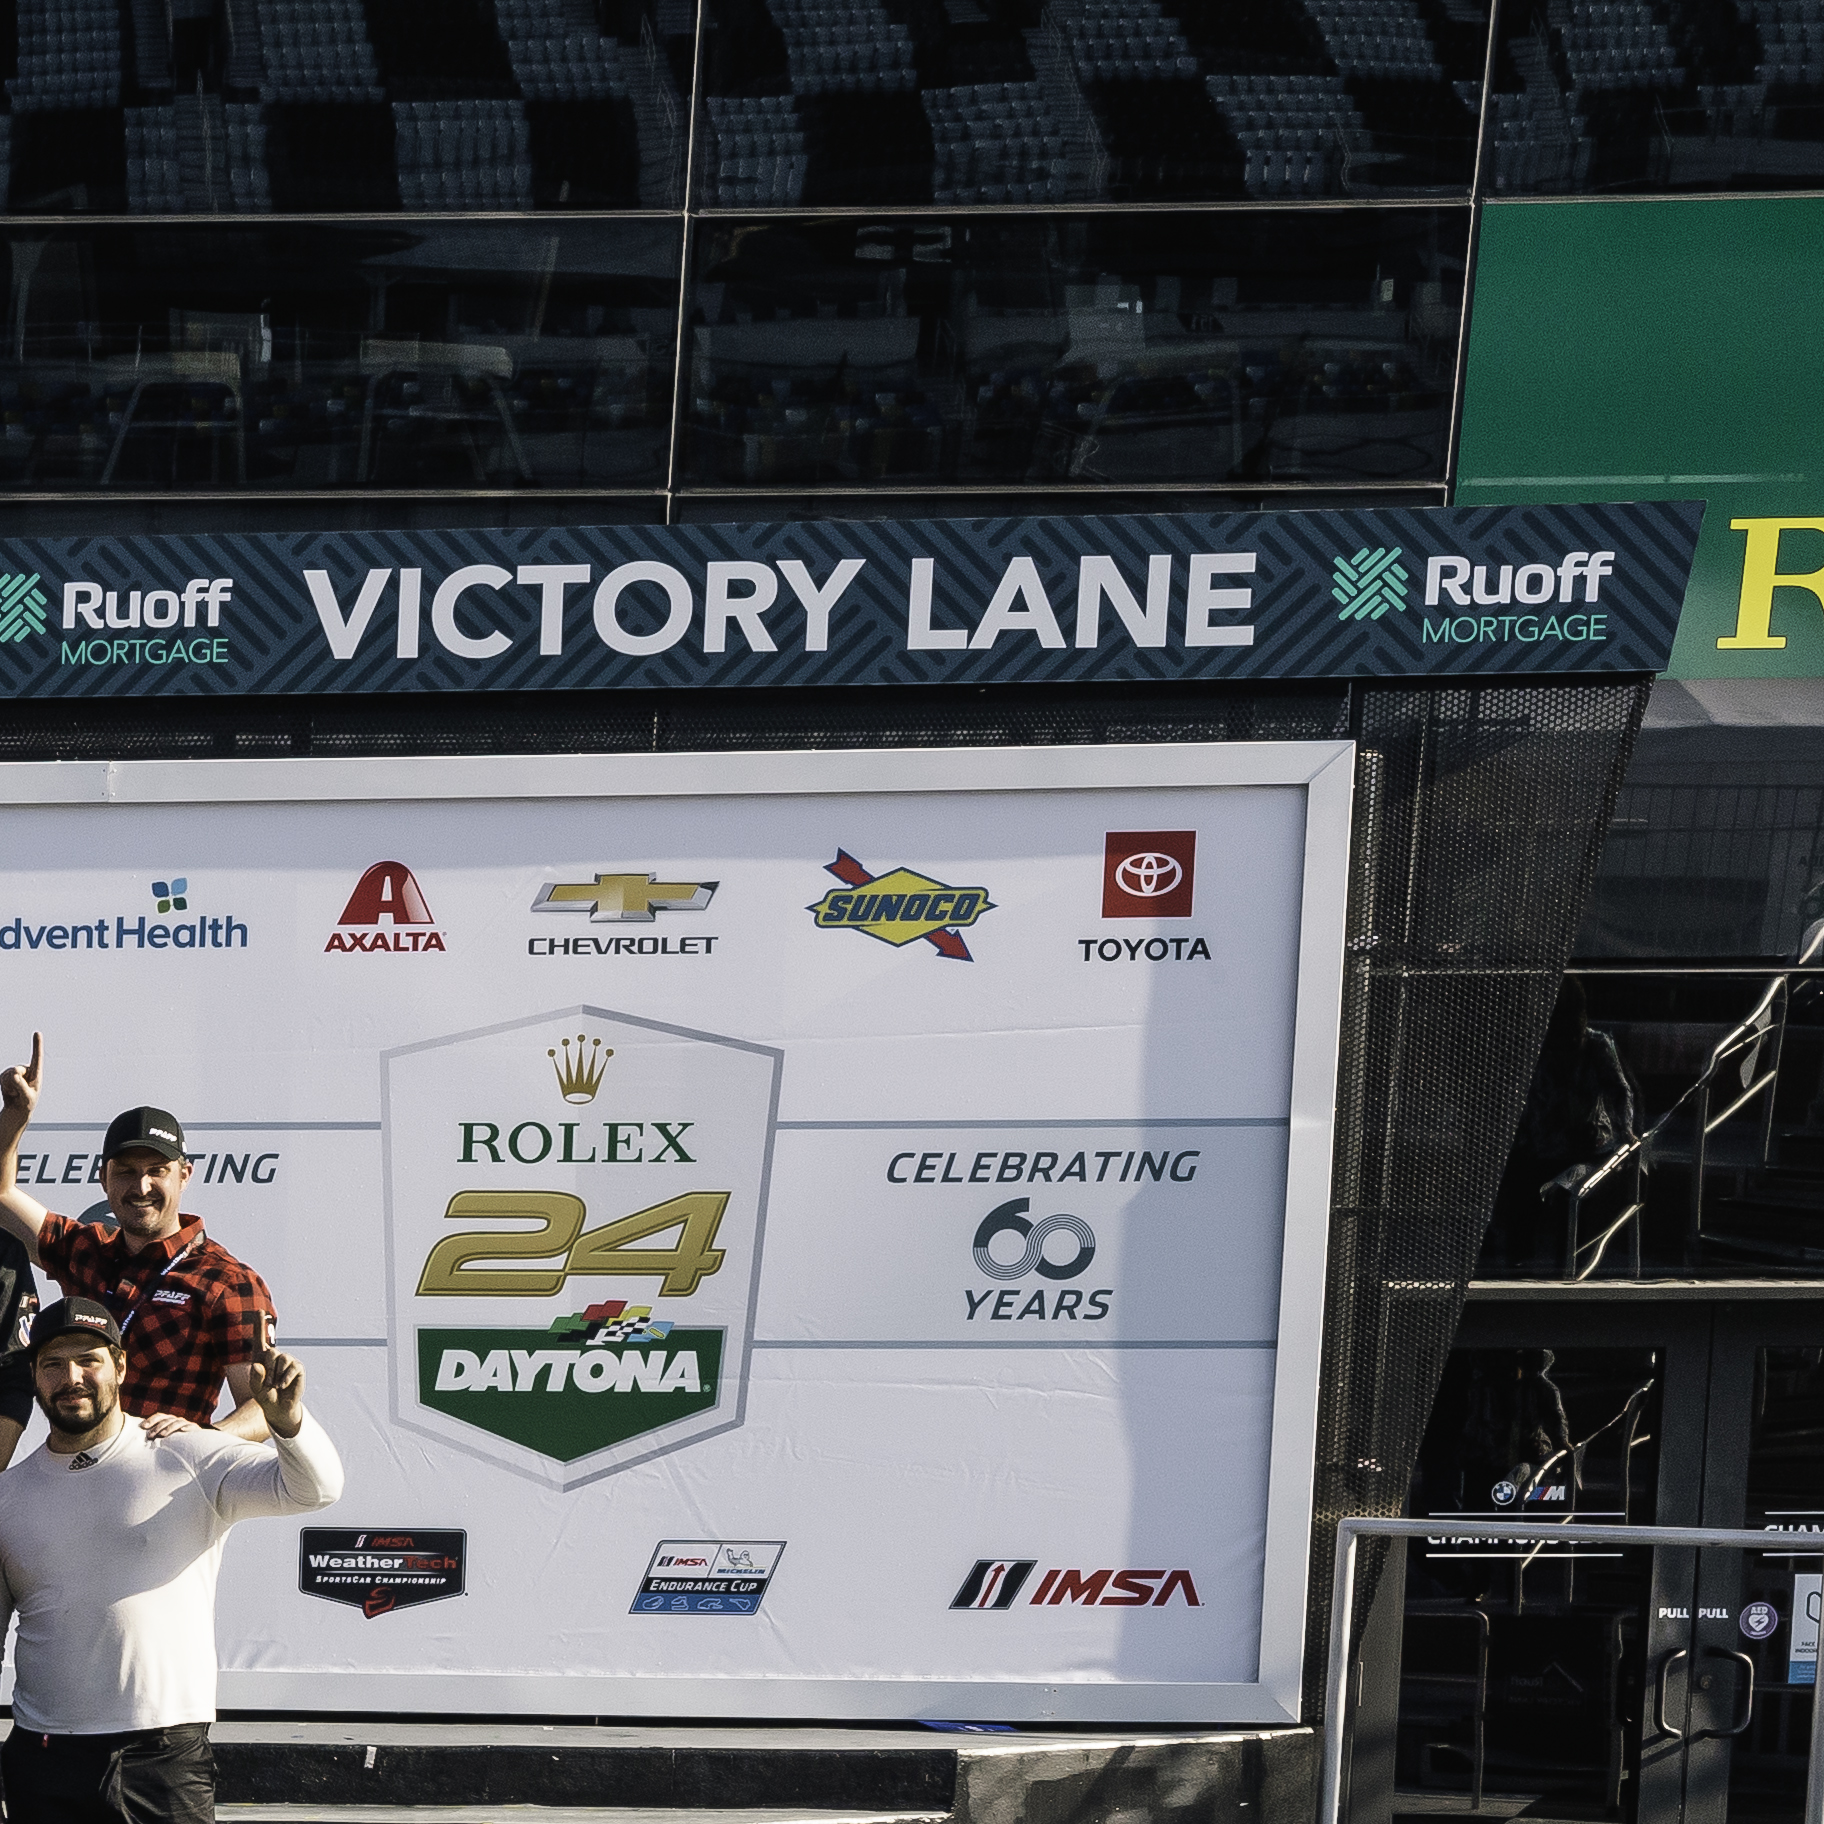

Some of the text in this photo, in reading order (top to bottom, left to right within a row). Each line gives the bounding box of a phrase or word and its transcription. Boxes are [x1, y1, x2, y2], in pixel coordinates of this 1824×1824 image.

[1424, 550, 1616, 607] Ruoff
[61, 577, 233, 629] Ruoff
[303, 552, 1258, 660] VICTORY LANE
[1421, 612, 1608, 645] MORTGAGE
[61, 638, 229, 666] MORTGAGE
[822, 892, 980, 924] SUNOCO
[324, 931, 444, 953] AXALTA
[527, 936, 719, 956] CHEVROLET
[1077, 938, 1212, 963] TOYOTA
[456, 1121, 697, 1165] ROLEX
[886, 1150, 1201, 1183] CELEBRATING
[415, 1190, 732, 1298] 24
[972, 1197, 1096, 1282] 60
[963, 1288, 1113, 1321] YEARS
[434, 1350, 702, 1394] DAYTONA
[309, 1555, 457, 1570] WeatherTech
[673, 1557, 708, 1567] IMSA
[1029, 1569, 1202, 1607] IMSA
[1658, 1608, 1690, 1619] PULL
[1698, 1608, 1729, 1619] PULL
